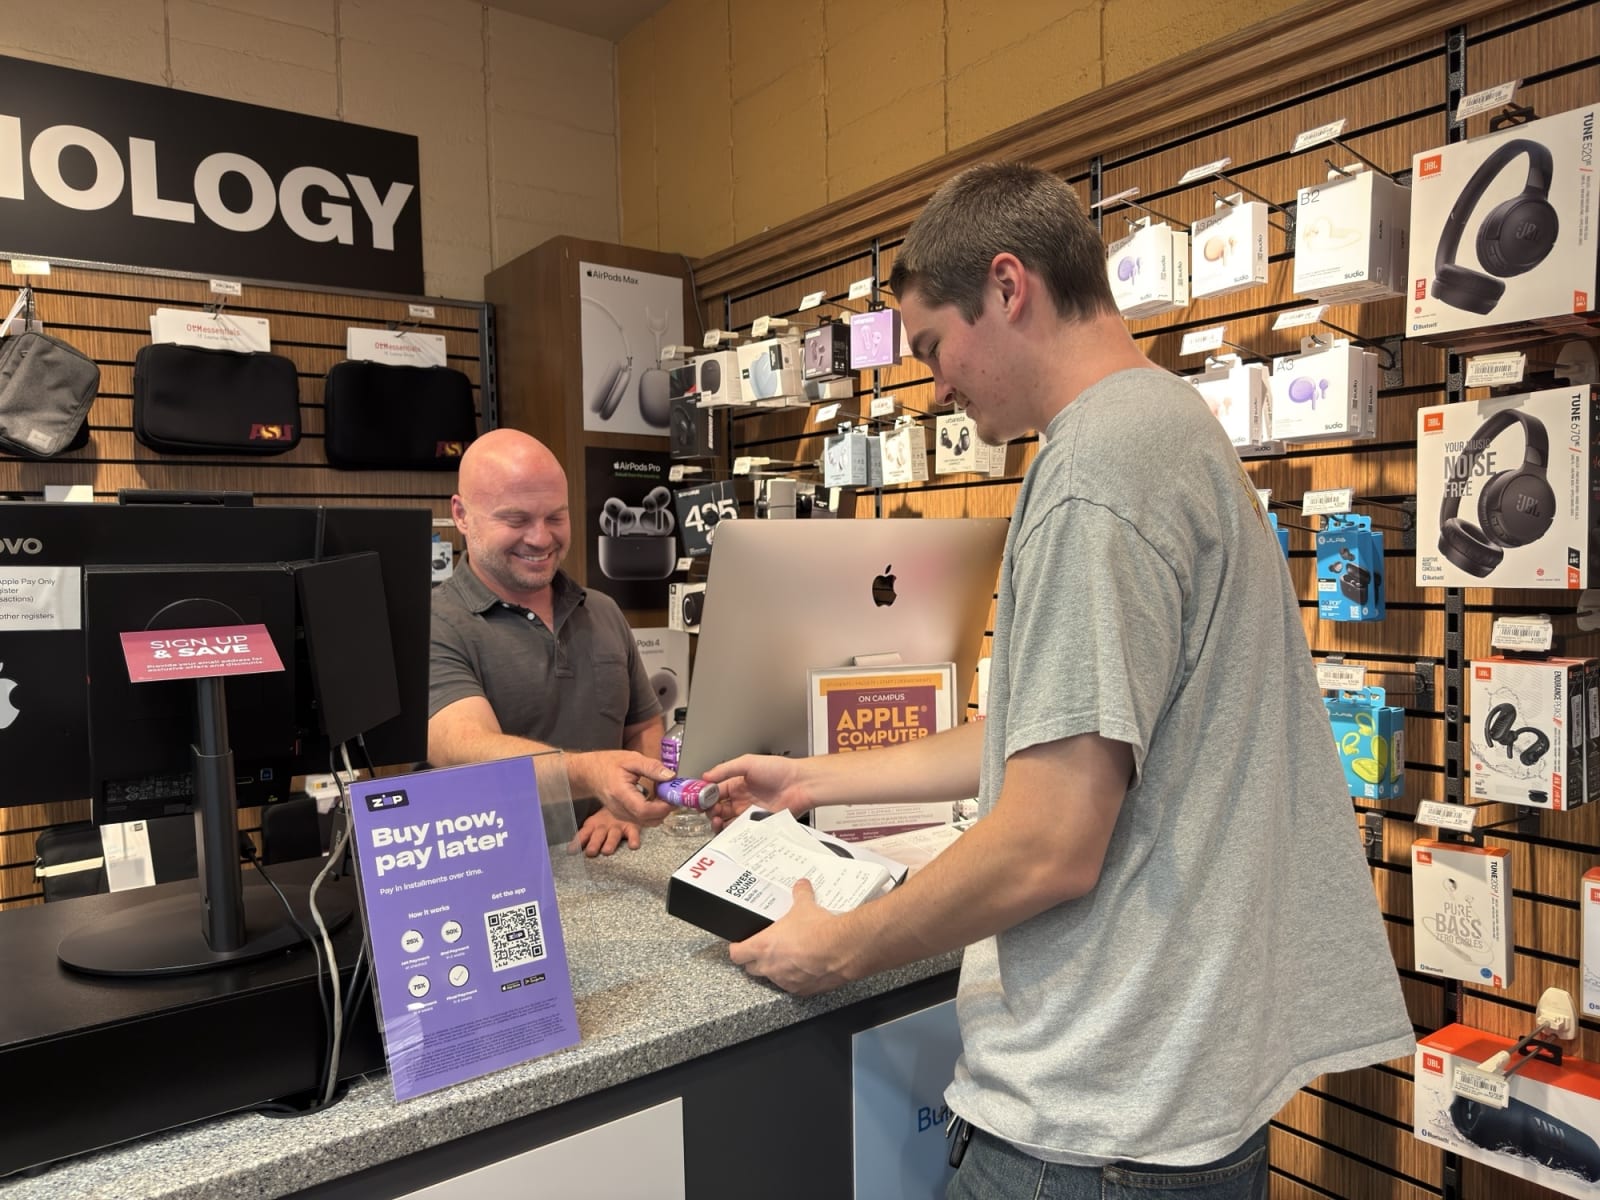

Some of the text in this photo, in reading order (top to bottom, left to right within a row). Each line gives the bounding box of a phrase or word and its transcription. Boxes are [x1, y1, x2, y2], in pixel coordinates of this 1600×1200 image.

[1583, 112, 1594, 141] TUNE
[1424, 160, 1439, 172] JBL
[0, 114, 414, 251] OLOGY
[1300, 189, 1320, 206] B2
[593, 270, 640, 285] AirPods Max
[1344, 269, 1365, 280] sudio
[1571, 393, 1581, 422] TUNE
[249, 423, 294, 441] ASU
[1324, 422, 1344, 433] sudio
[1445, 437, 1490, 454] YOUR MUSIC
[620, 461, 661, 472] AirPods Pro
[1444, 451, 1497, 481] NOISE
[1444, 480, 1473, 499] FREE
[1516, 493, 1541, 518] JBL
[0, 537, 43, 555] vo
[21, 578, 37, 587] Pay
[38, 578, 56, 587] Only
[22, 612, 55, 621] registers
[150, 634, 249, 650] SIGN UP
[637, 638, 656, 647] Pods
[153, 643, 251, 660] & SAVE
[1553, 670, 1562, 701] ENDURANCE
[858, 692, 906, 704] ON CAMPUS
[371, 810, 504, 849] Buy now,
[374, 830, 508, 878] pay later
[689, 857, 715, 879] JVC
[1490, 861, 1498, 878] TUNE
[379, 867, 484, 897] Pay in installments over time.
[733, 876, 757, 898] SOUND
[491, 887, 526, 901] Get the app
[408, 911, 423, 920] How
[430, 904, 450, 914] works
[1444, 902, 1472, 920] PURE
[1435, 913, 1482, 939] BASS
[1436, 932, 1483, 949] ZERO CABLES
[1427, 1057, 1441, 1070] JBL
